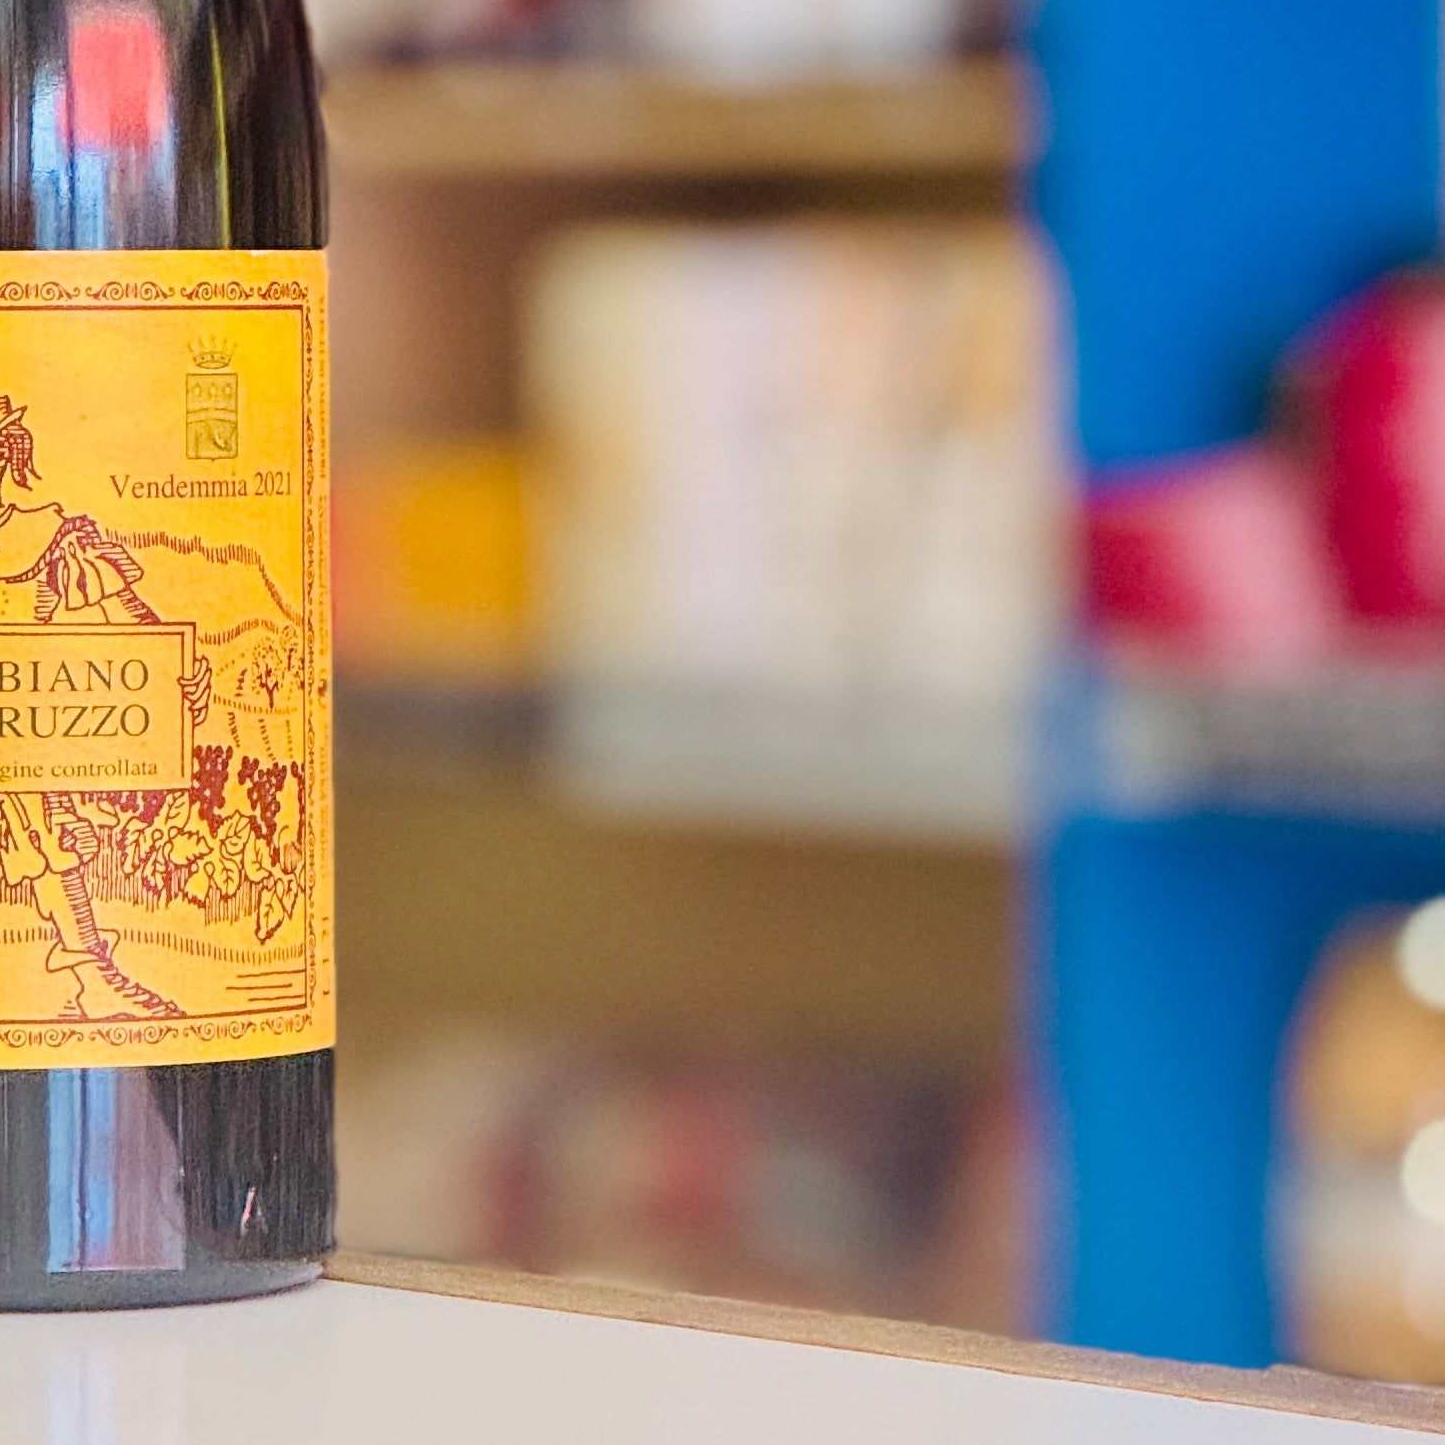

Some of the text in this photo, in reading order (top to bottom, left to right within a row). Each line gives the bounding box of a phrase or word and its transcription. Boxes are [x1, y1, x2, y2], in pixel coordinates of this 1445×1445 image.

[109, 470, 292, 499] Vendemmia 2021
[51, 758, 158, 778] controllata
